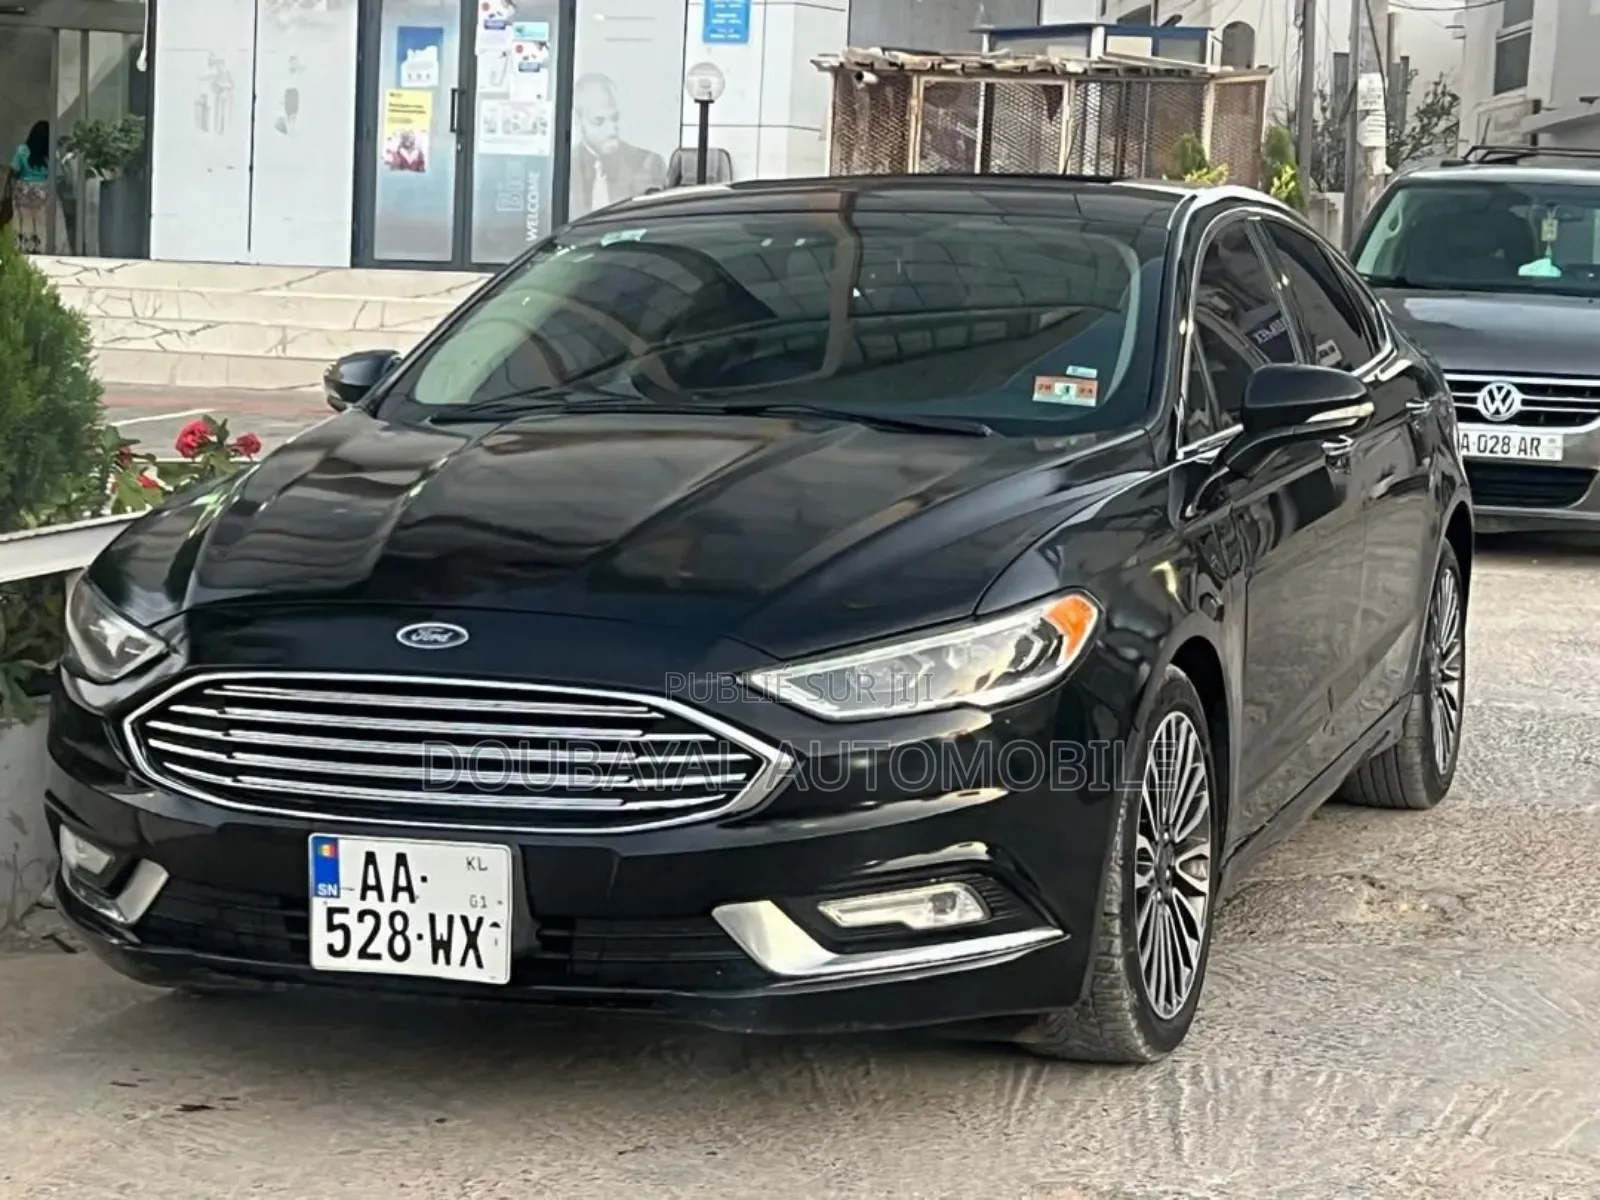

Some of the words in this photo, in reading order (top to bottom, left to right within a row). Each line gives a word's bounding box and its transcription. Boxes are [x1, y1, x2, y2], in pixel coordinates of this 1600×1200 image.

[526, 171, 539, 241] WELCOME
[1477, 434, 1511, 455] 028
[1517, 436, 1541, 456] AR
[466, 856, 488, 871] KL
[317, 883, 338, 896] SN
